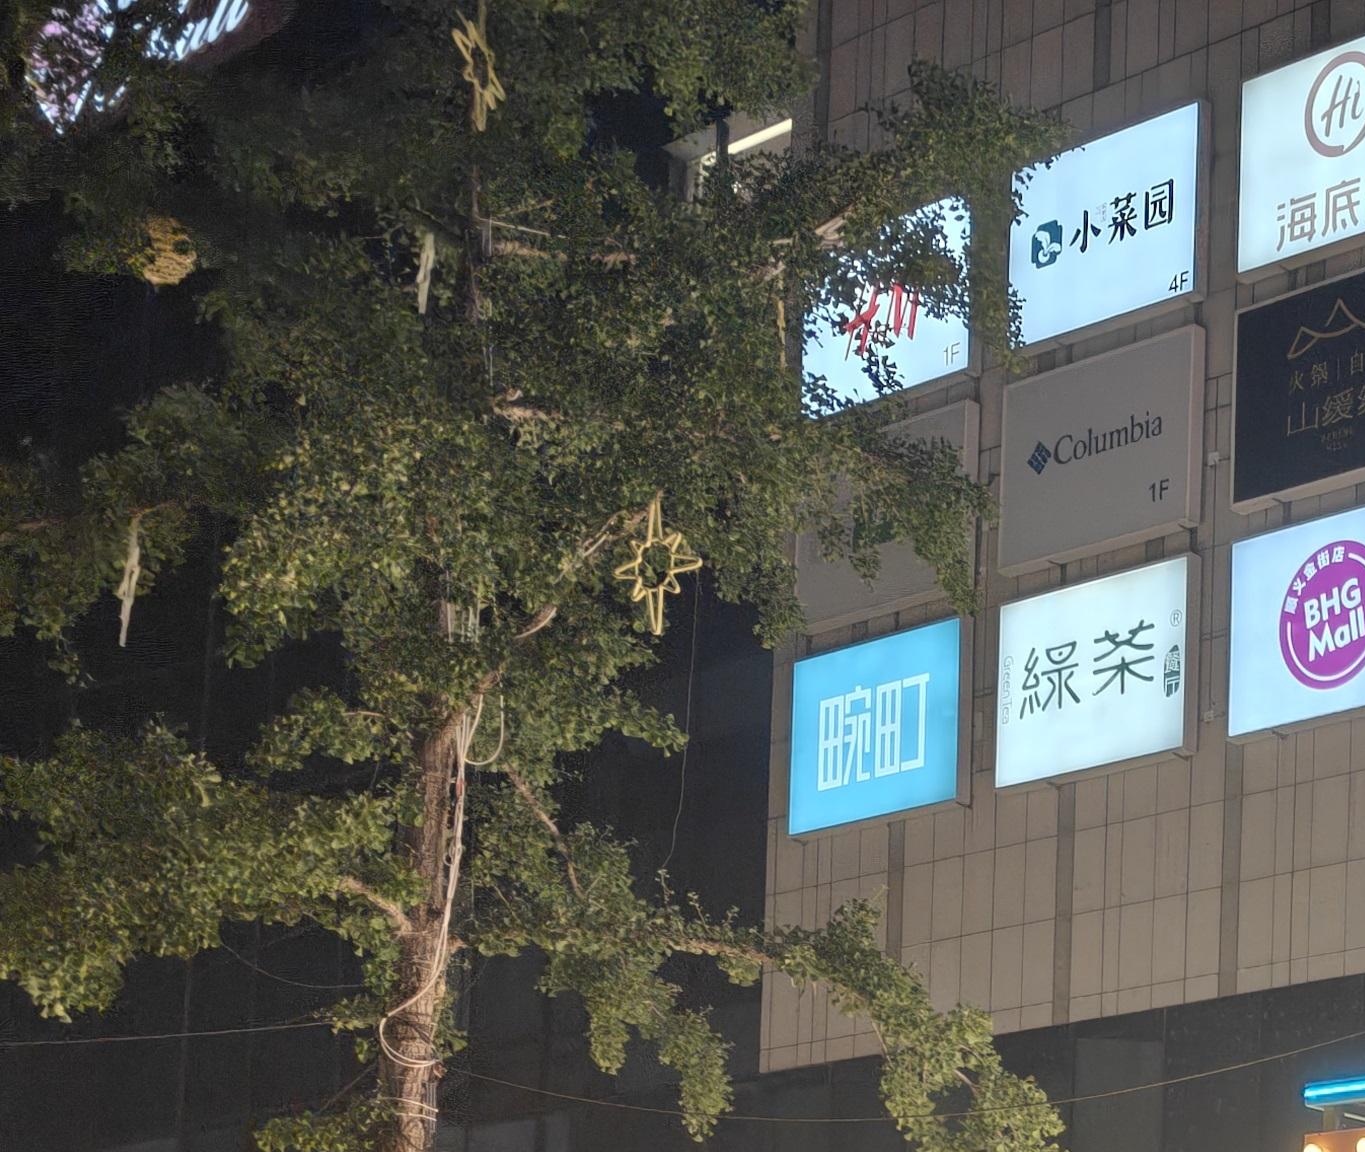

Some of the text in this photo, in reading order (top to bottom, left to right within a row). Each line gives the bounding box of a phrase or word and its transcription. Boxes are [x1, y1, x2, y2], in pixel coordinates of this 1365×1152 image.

[1069, 178, 1175, 254] 小菜园
[1168, 270, 1190, 294] 4F
[943, 342, 961, 366] 1F
[1052, 410, 1164, 465] Columbia
[1149, 478, 1170, 502] 1F
[1304, 577, 1362, 630] BHG
